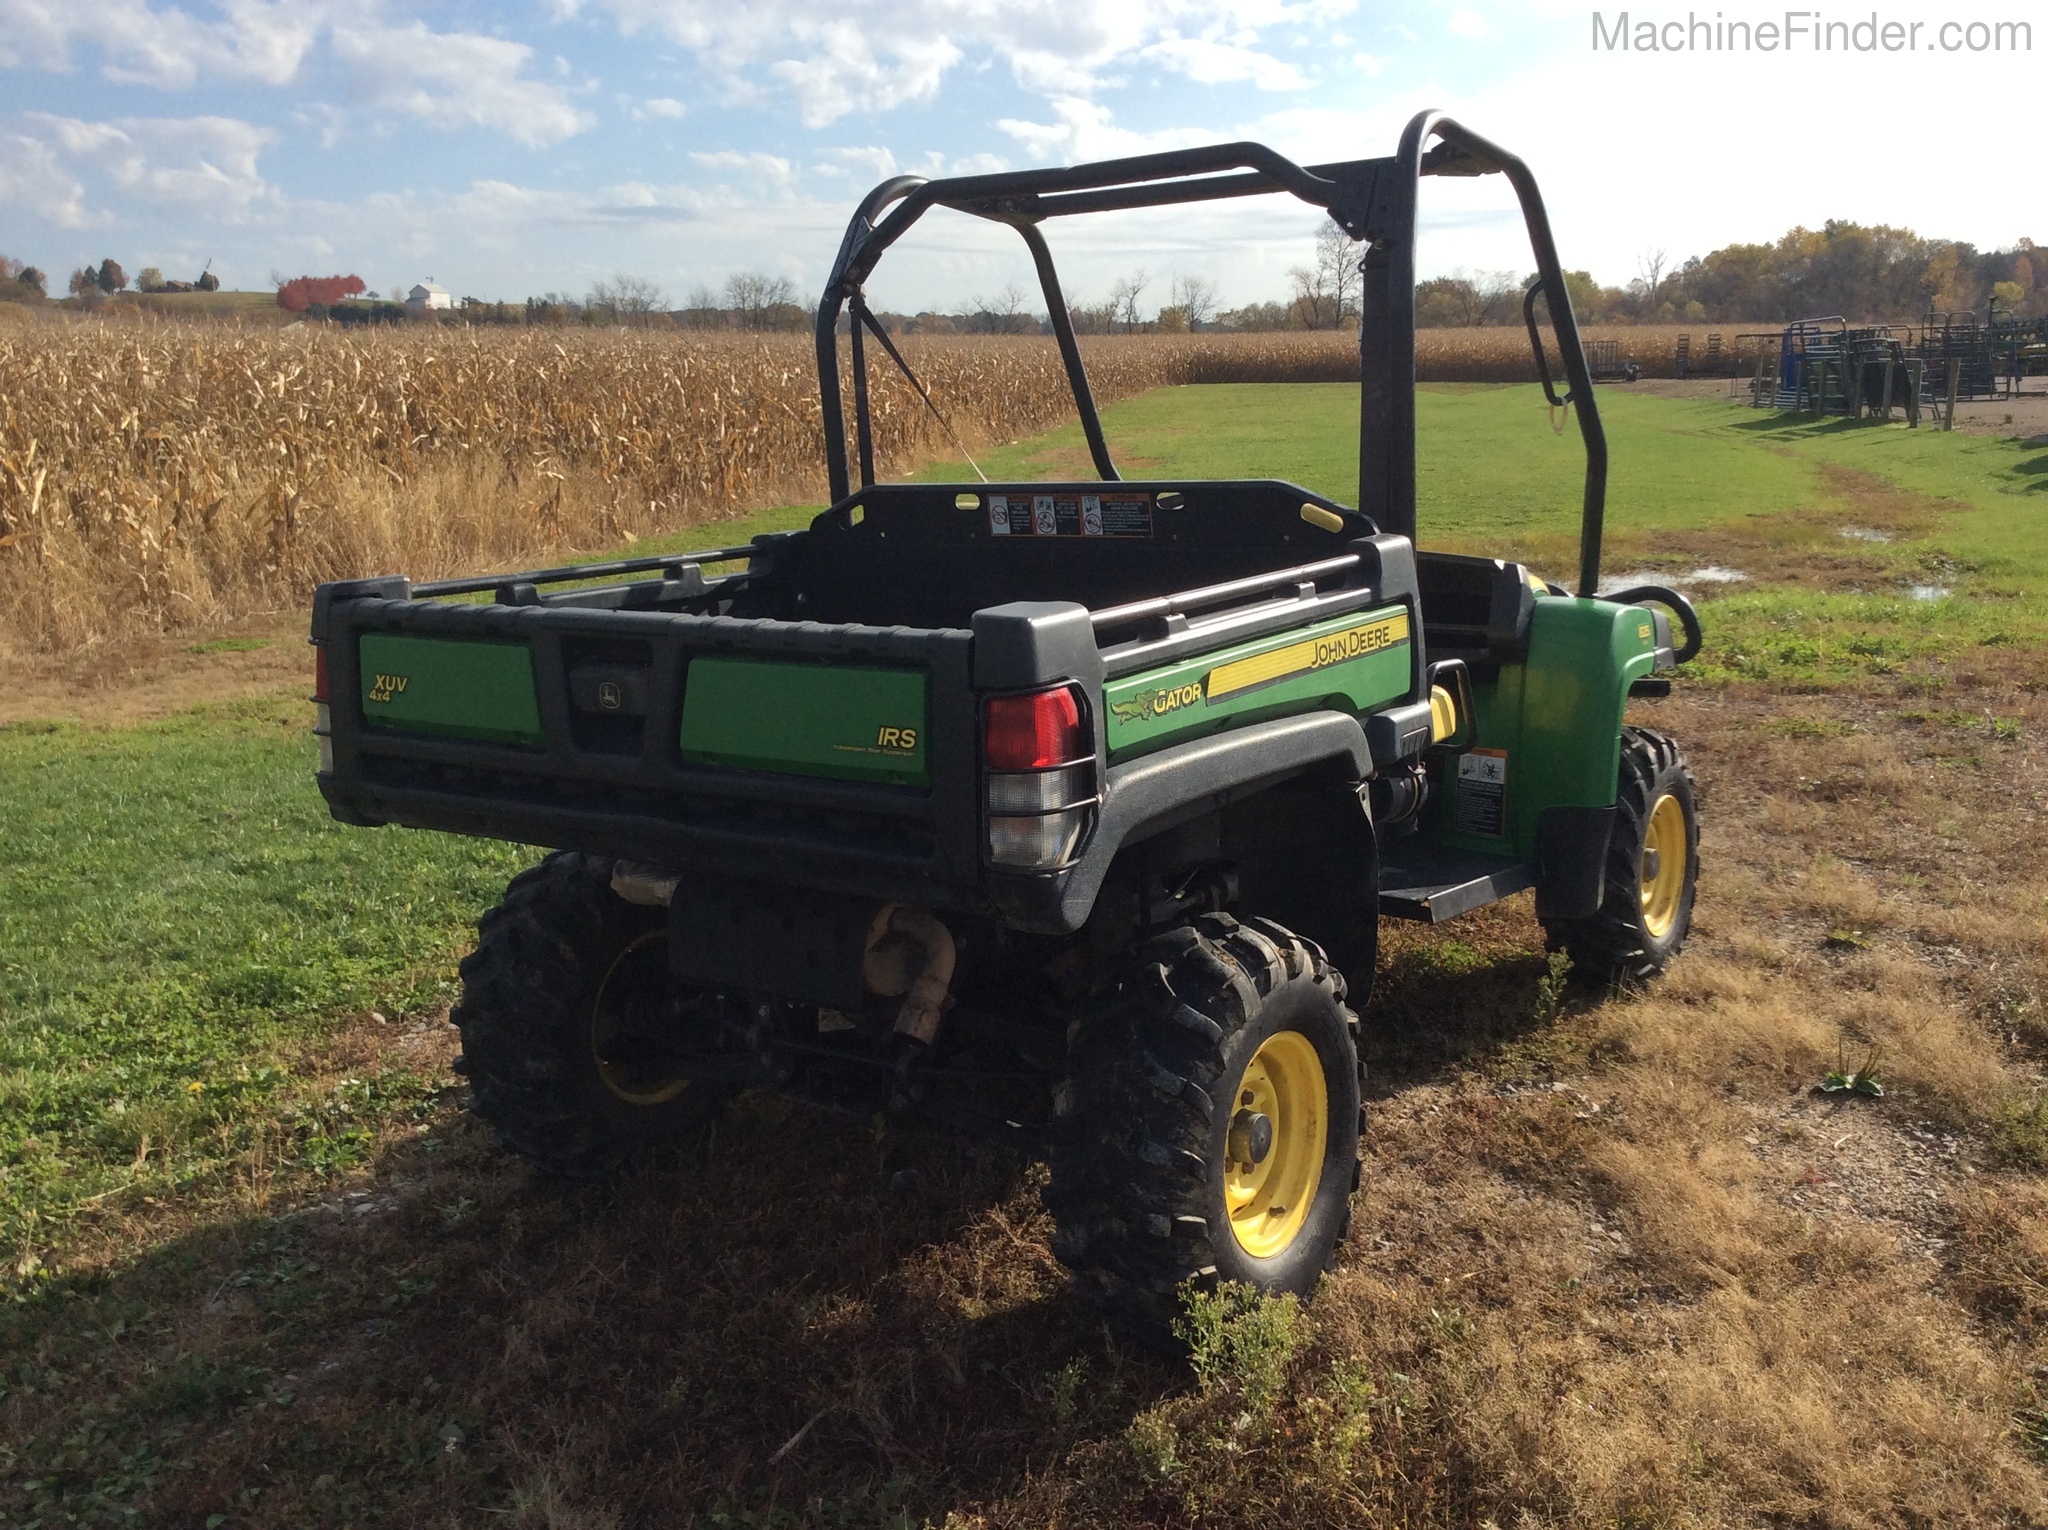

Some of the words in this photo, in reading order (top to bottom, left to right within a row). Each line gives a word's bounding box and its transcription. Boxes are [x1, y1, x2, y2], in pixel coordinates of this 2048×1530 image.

[1311, 638, 1347, 666] JOHN
[1349, 625, 1391, 652] DEERE
[375, 674, 408, 692] XUV
[368, 689, 391, 702] 4x4
[1153, 681, 1202, 714] GATOR
[877, 727, 917, 749] IRS
